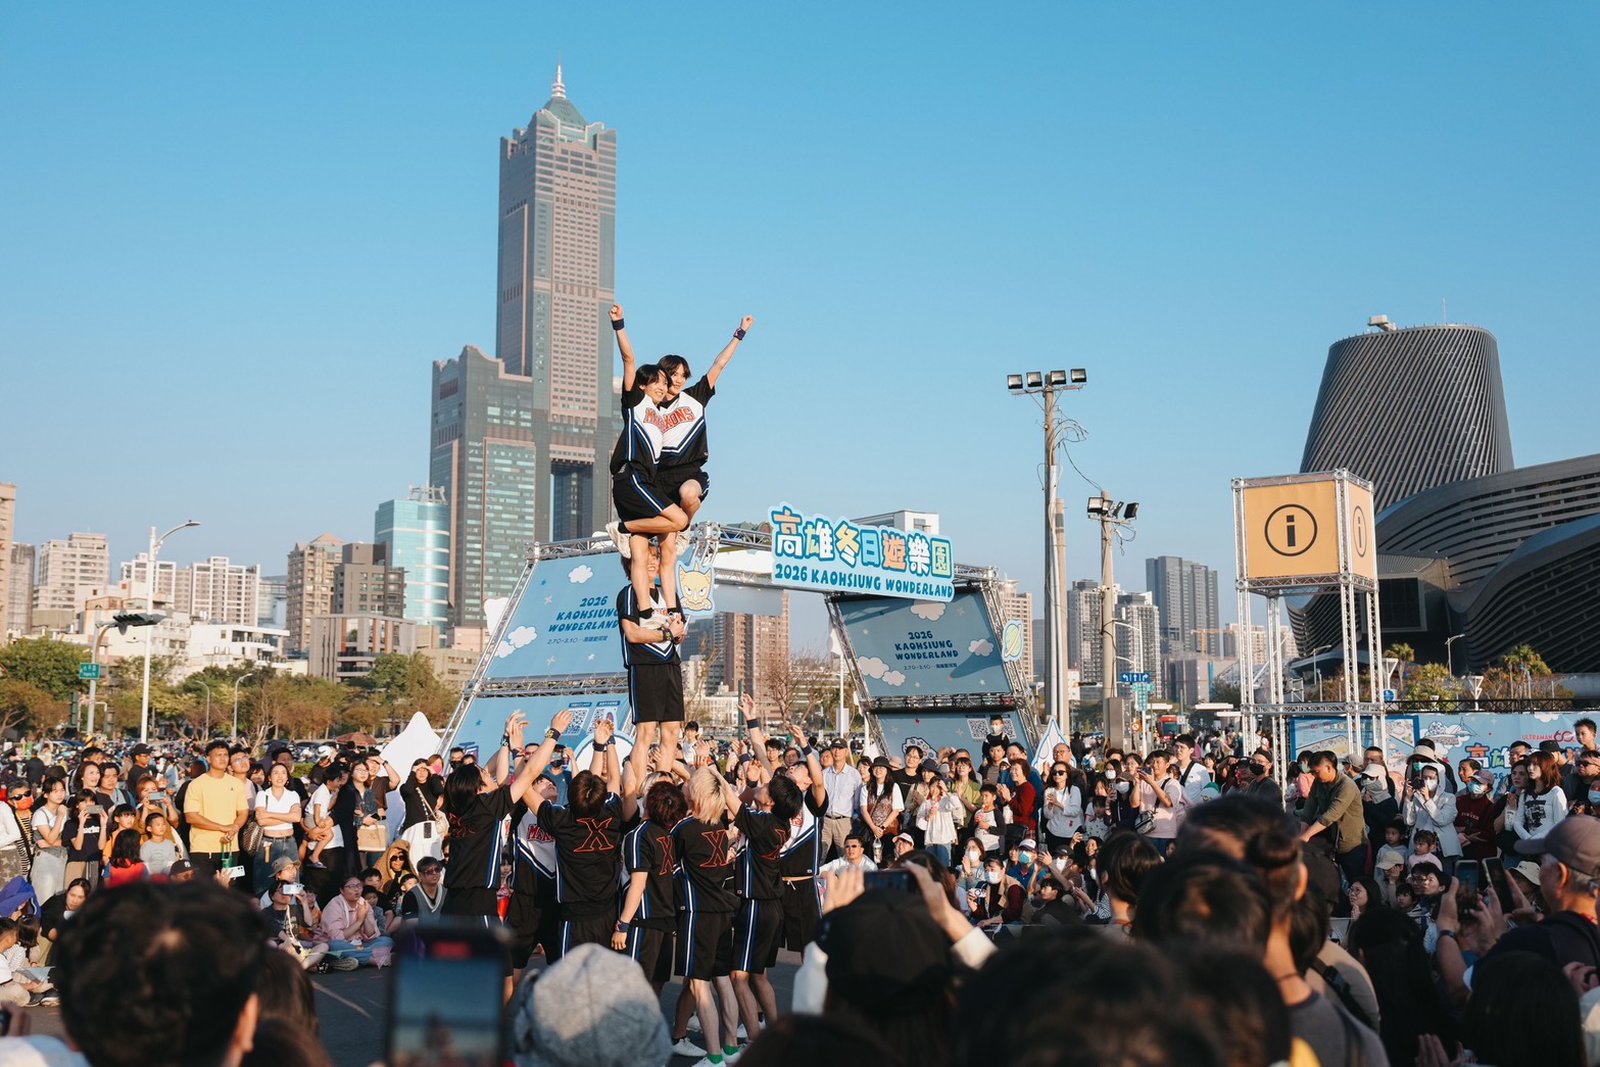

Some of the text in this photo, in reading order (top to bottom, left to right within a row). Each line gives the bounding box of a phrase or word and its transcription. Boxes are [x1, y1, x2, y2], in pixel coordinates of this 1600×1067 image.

[771, 505, 953, 579] 高雄冬日遊樂園
[775, 563, 953, 598] 2026 KAOHSIUNG WONDERLAND
[579, 596, 608, 607] 2026
[549, 620, 619, 632] WONDERLAND
[907, 630, 933, 640] 2026
[894, 640, 953, 651] KAOHSIUNG
[895, 650, 958, 660] WONDERLAND
[574, 818, 614, 853] X
[656, 836, 676, 876] X
[700, 829, 728, 868] X
